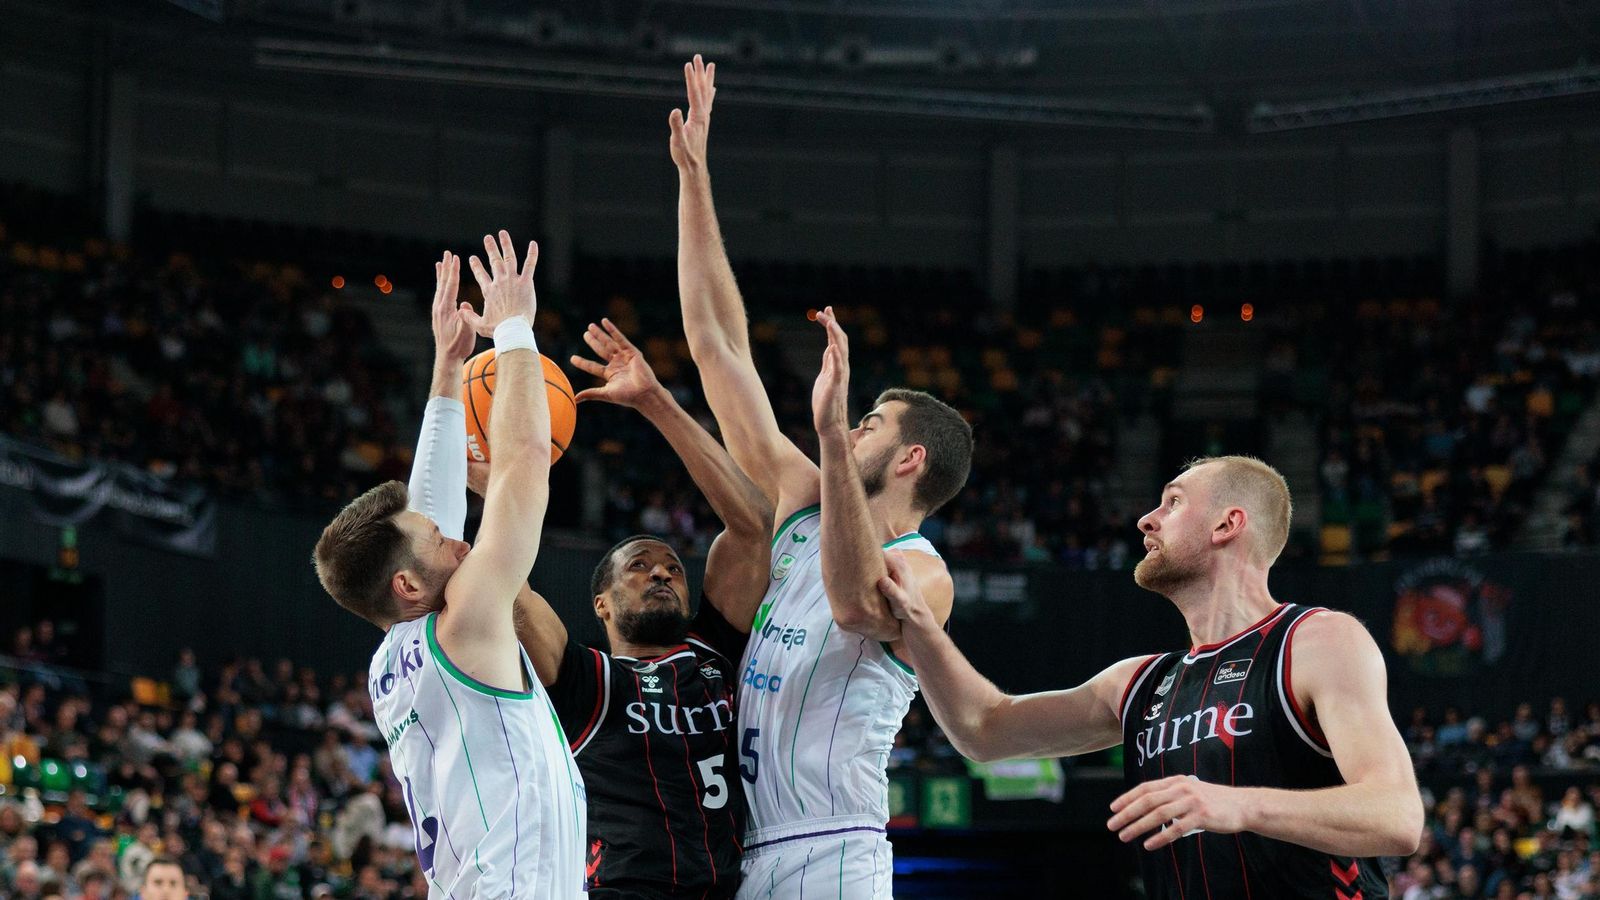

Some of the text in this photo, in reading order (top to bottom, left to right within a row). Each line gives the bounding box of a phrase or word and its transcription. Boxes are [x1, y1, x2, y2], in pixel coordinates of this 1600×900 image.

[641, 686, 663, 694] hummel
[1217, 671, 1246, 681] endesa
[625, 699, 735, 735] surn
[1136, 702, 1254, 767] surne
[697, 753, 729, 810] 5
